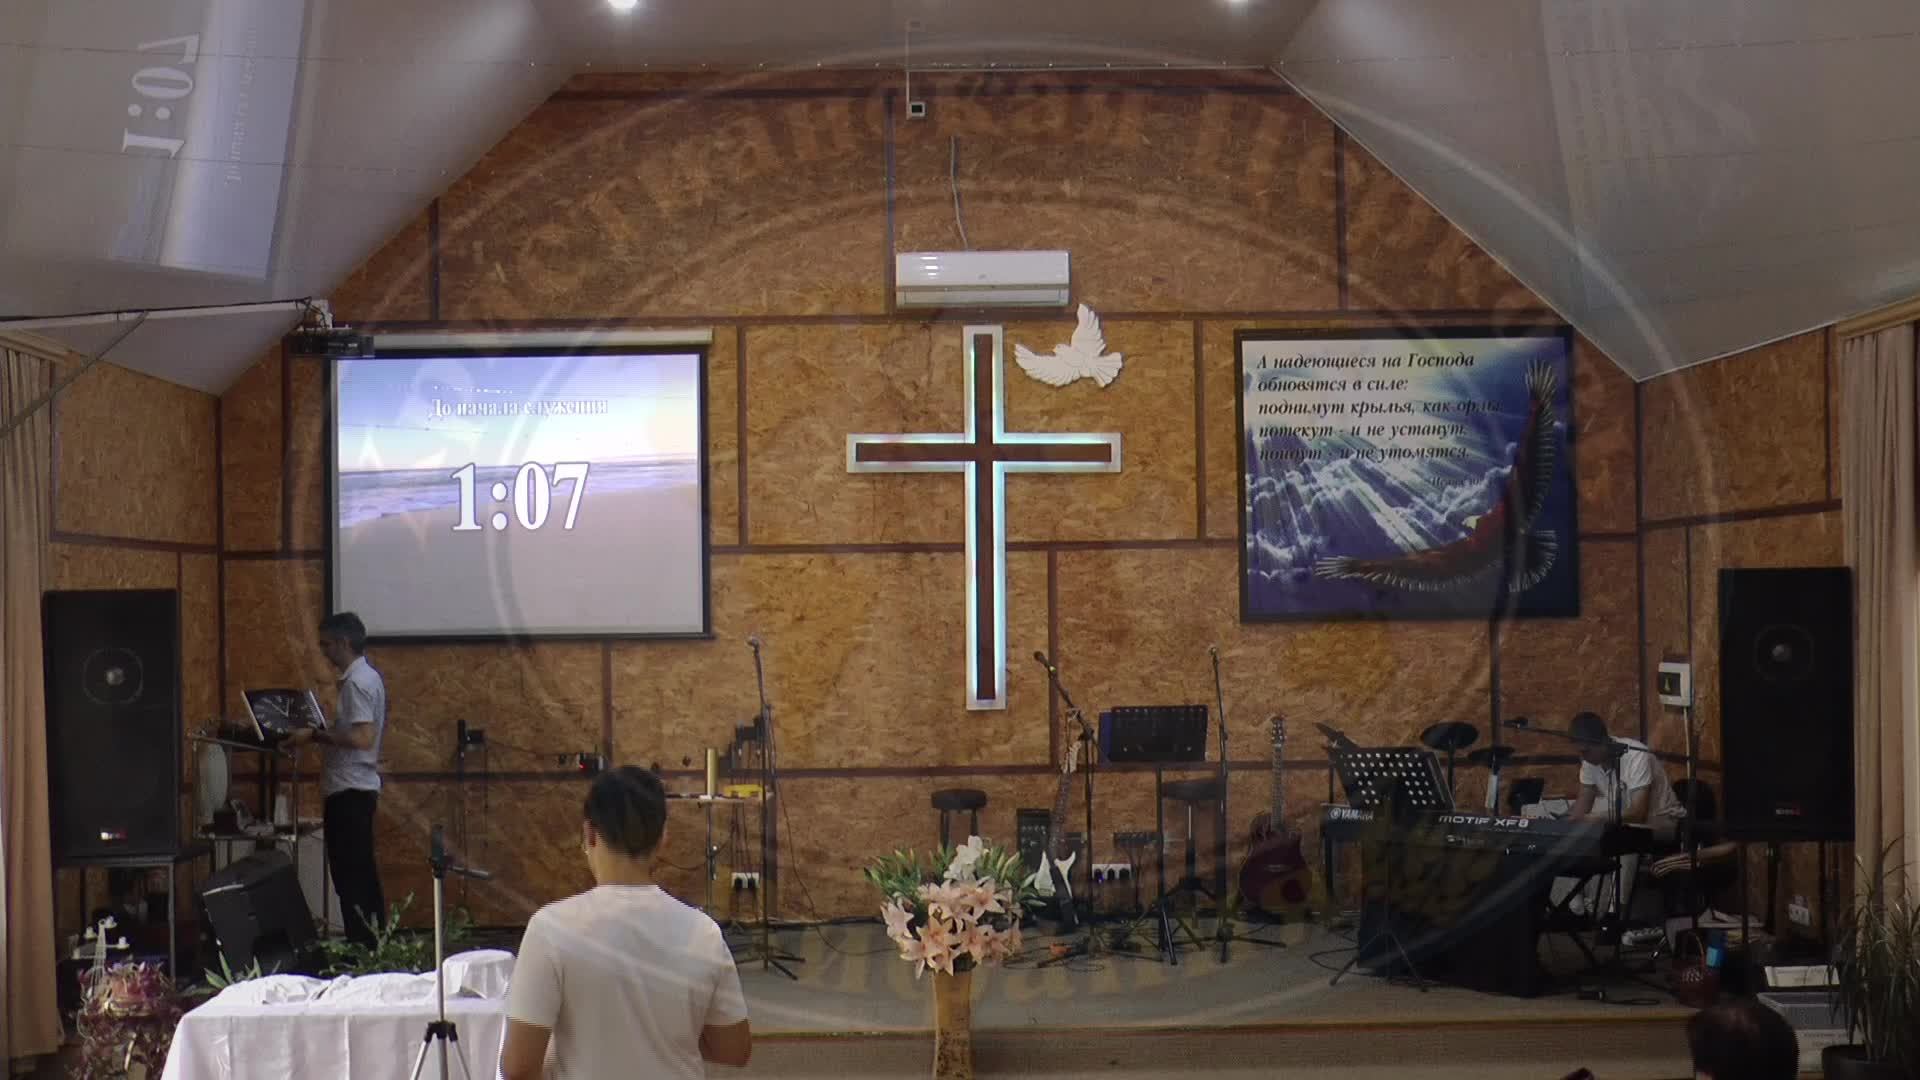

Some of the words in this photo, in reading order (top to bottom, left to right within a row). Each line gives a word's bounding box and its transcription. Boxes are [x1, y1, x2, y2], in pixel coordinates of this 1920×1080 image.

[1257, 354, 1268, 368] А
[1273, 353, 1376, 371] надеющиеся
[1381, 356, 1402, 368] на
[1407, 352, 1475, 368] Господа
[1257, 376, 1347, 392] обновятся
[1352, 379, 1362, 391] в
[426, 399, 452, 418] До
[1258, 398, 1345, 418] поднимут
[1350, 400, 1415, 418] крылья,
[1423, 401, 1451, 413] как
[1259, 424, 1333, 441] потекут
[1350, 425, 1361, 437] и
[1367, 425, 1385, 437] не
[1339, 448, 1350, 459] и
[1356, 447, 1375, 460] не
[1378, 446, 1470, 463] утомятся.
[450, 460, 591, 532] 1:07
[1438, 814, 1490, 826] MOTIF
[1494, 817, 1529, 829] XF8
